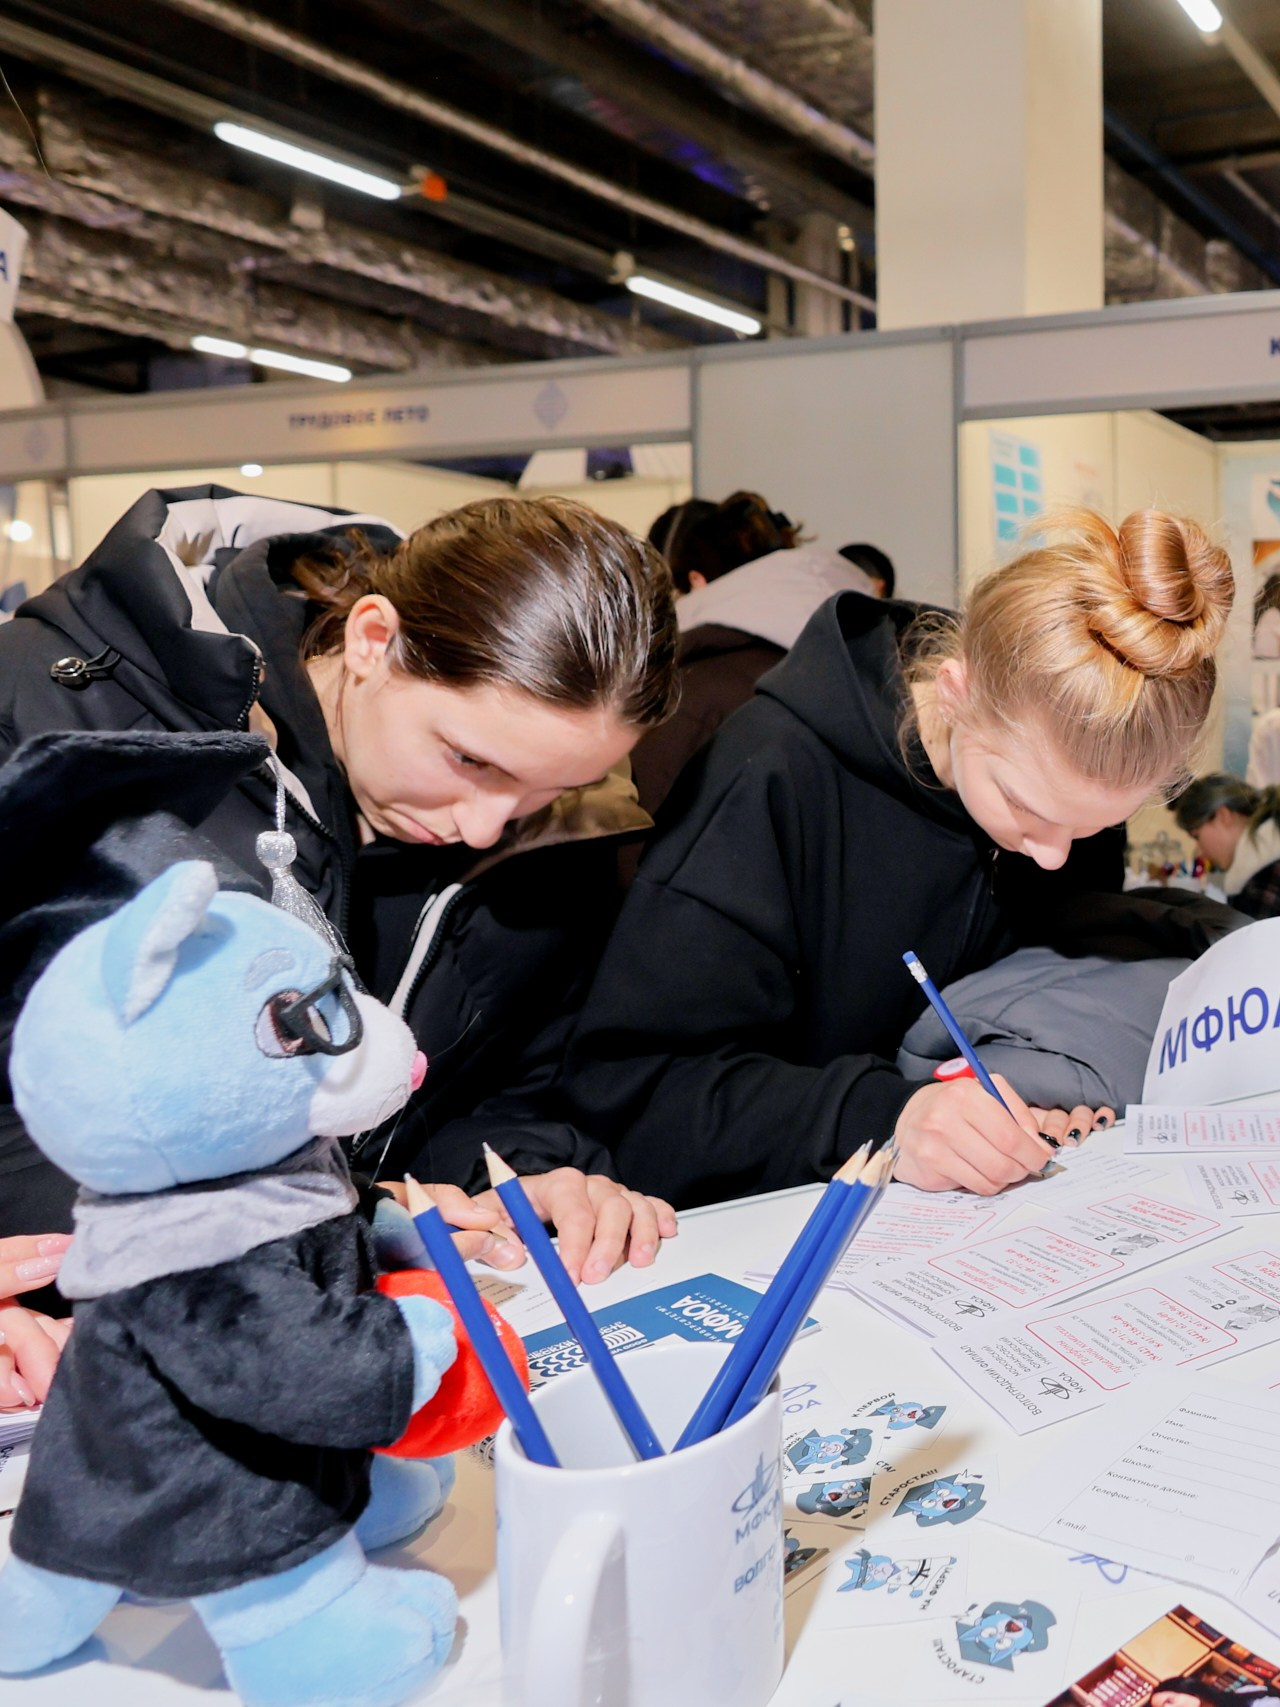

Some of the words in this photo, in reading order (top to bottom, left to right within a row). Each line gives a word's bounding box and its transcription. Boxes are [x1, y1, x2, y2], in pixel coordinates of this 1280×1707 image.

[670, 1295, 745, 1339] МФЮА
[958, 1344, 992, 1368] ФИЛИАЛ
[982, 1366, 1045, 1415] ВОЛГОГРАДСКИЙ
[1055, 1371, 1088, 1393] МФЮА
[783, 1399, 822, 1415] ЮА
[1178, 1407, 1219, 1421] Фамилия:
[1165, 1419, 1185, 1429] Имя:
[1151, 1431, 1192, 1446] Отчество:
[1136, 1444, 1163, 1455] Класс:
[1122, 1457, 1153, 1470] Школа:
[880, 1468, 939, 1507] СТАРОСТА!!!
[1091, 1485, 1132, 1502] Телефон:
[1106, 1471, 1160, 1489] Контактные
[1159, 1485, 1199, 1500] данные:
[1056, 1518, 1088, 1533] E-mail:
[932, 1638, 985, 1685] СТАРОСТА!!!
